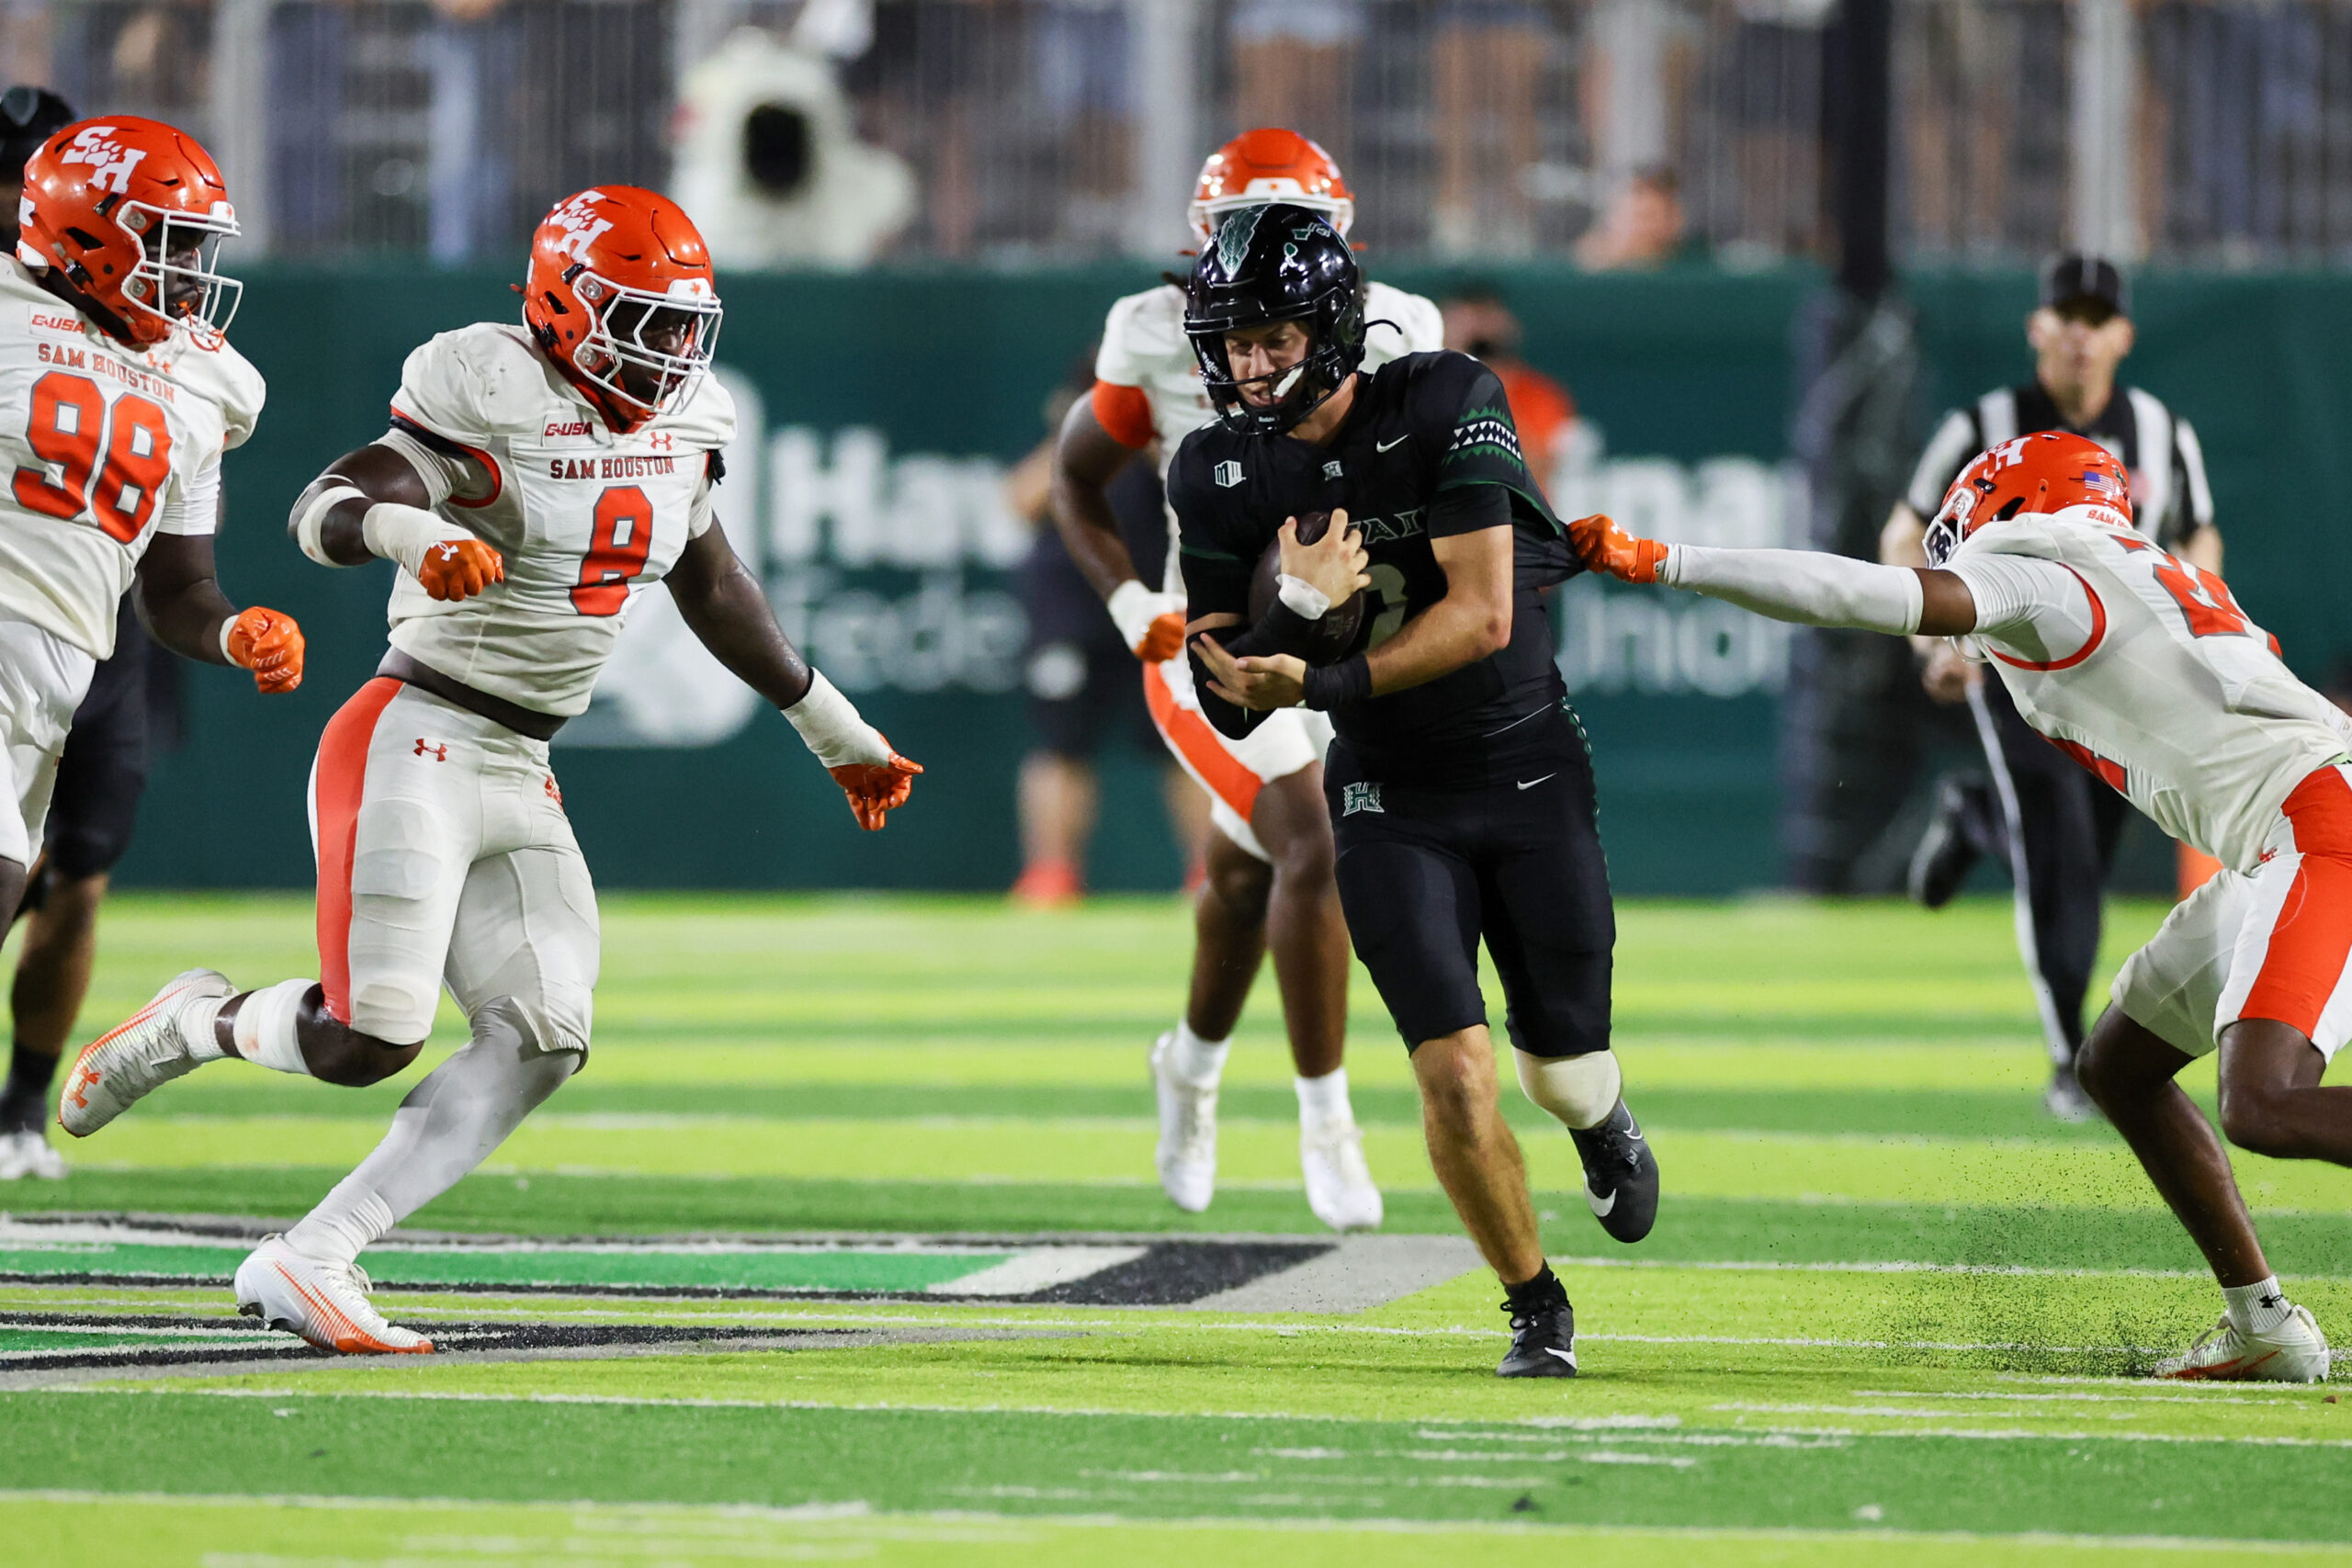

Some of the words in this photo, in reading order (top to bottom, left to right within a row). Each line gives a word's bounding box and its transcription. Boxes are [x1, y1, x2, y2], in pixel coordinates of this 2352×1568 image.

[61, 125, 148, 194] SH
[38, 343, 85, 369] SAM
[92, 354, 175, 404] HOUSTON
[10, 369, 173, 546] 98
[550, 458, 596, 479] SAM
[602, 456, 675, 479] HOUSTON
[568, 484, 653, 617] 8
[770, 574, 1029, 694] Fede
